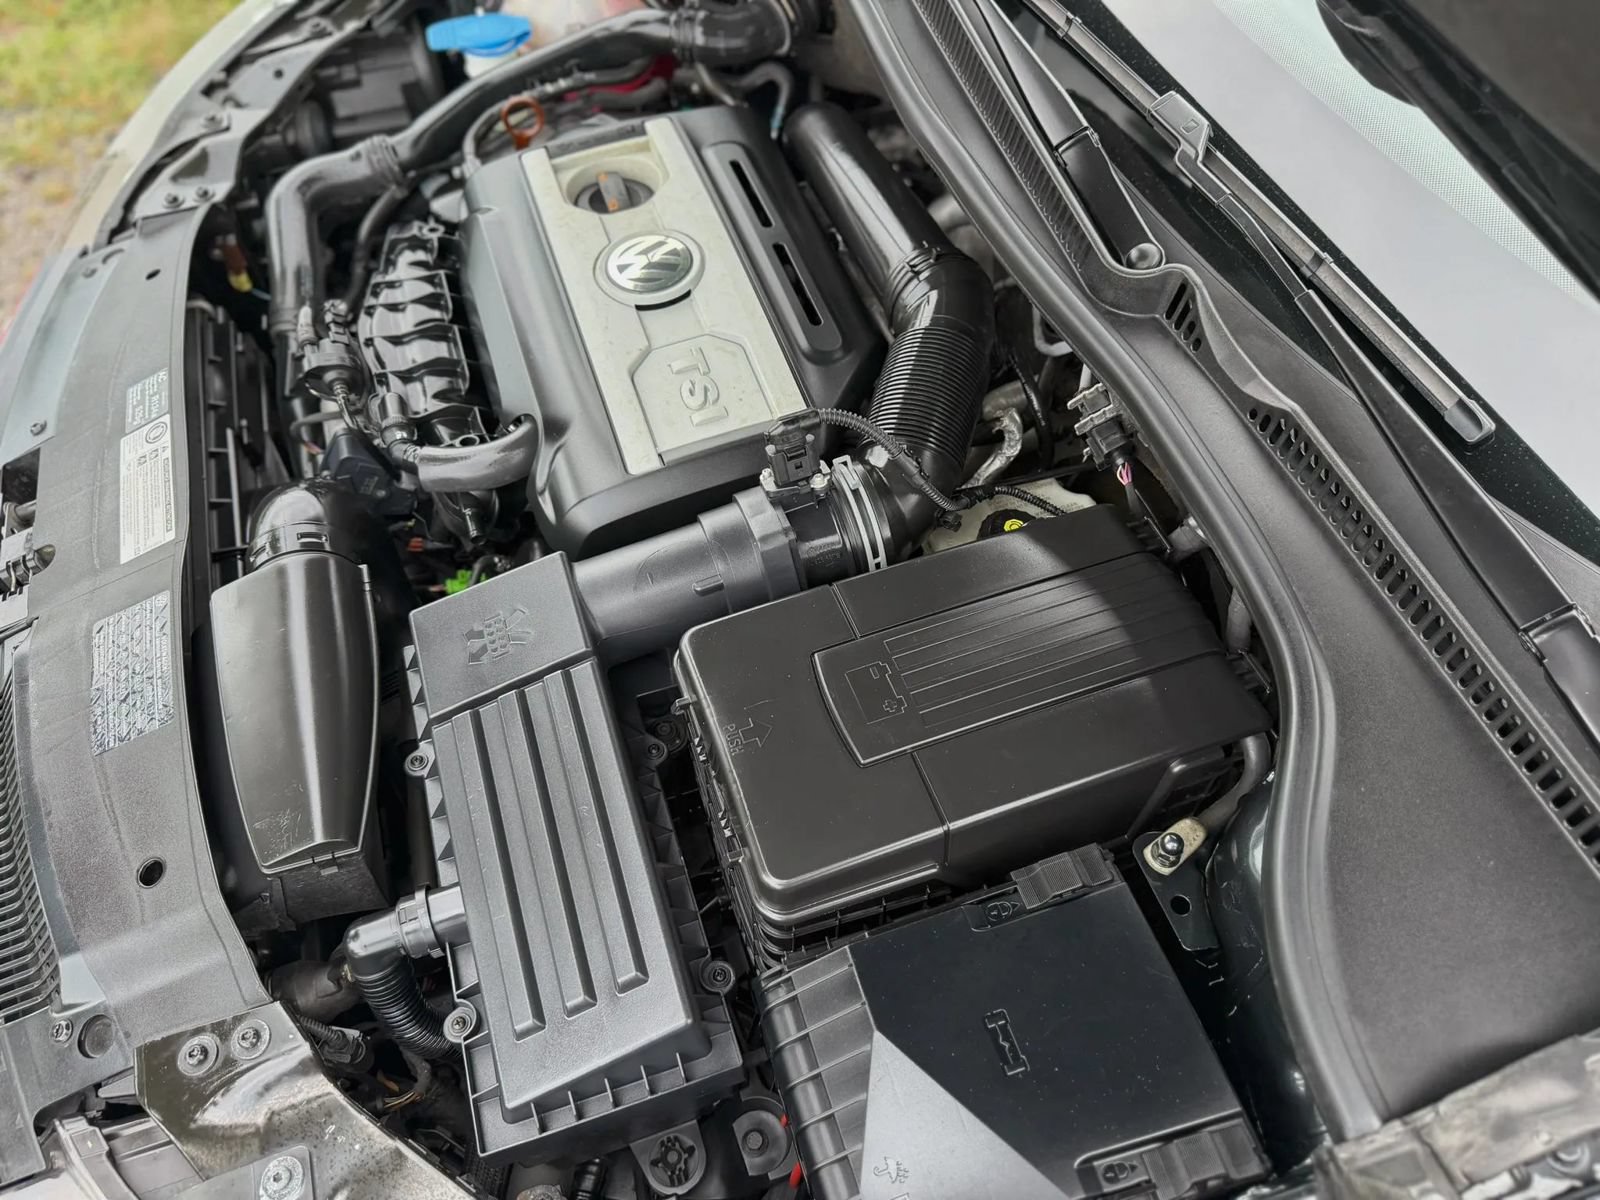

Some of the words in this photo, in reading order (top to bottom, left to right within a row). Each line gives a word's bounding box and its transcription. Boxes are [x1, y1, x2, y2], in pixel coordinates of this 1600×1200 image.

[606, 235, 693, 292] VW
[667, 346, 729, 427] TSI
[722, 723, 745, 756] PUSH
